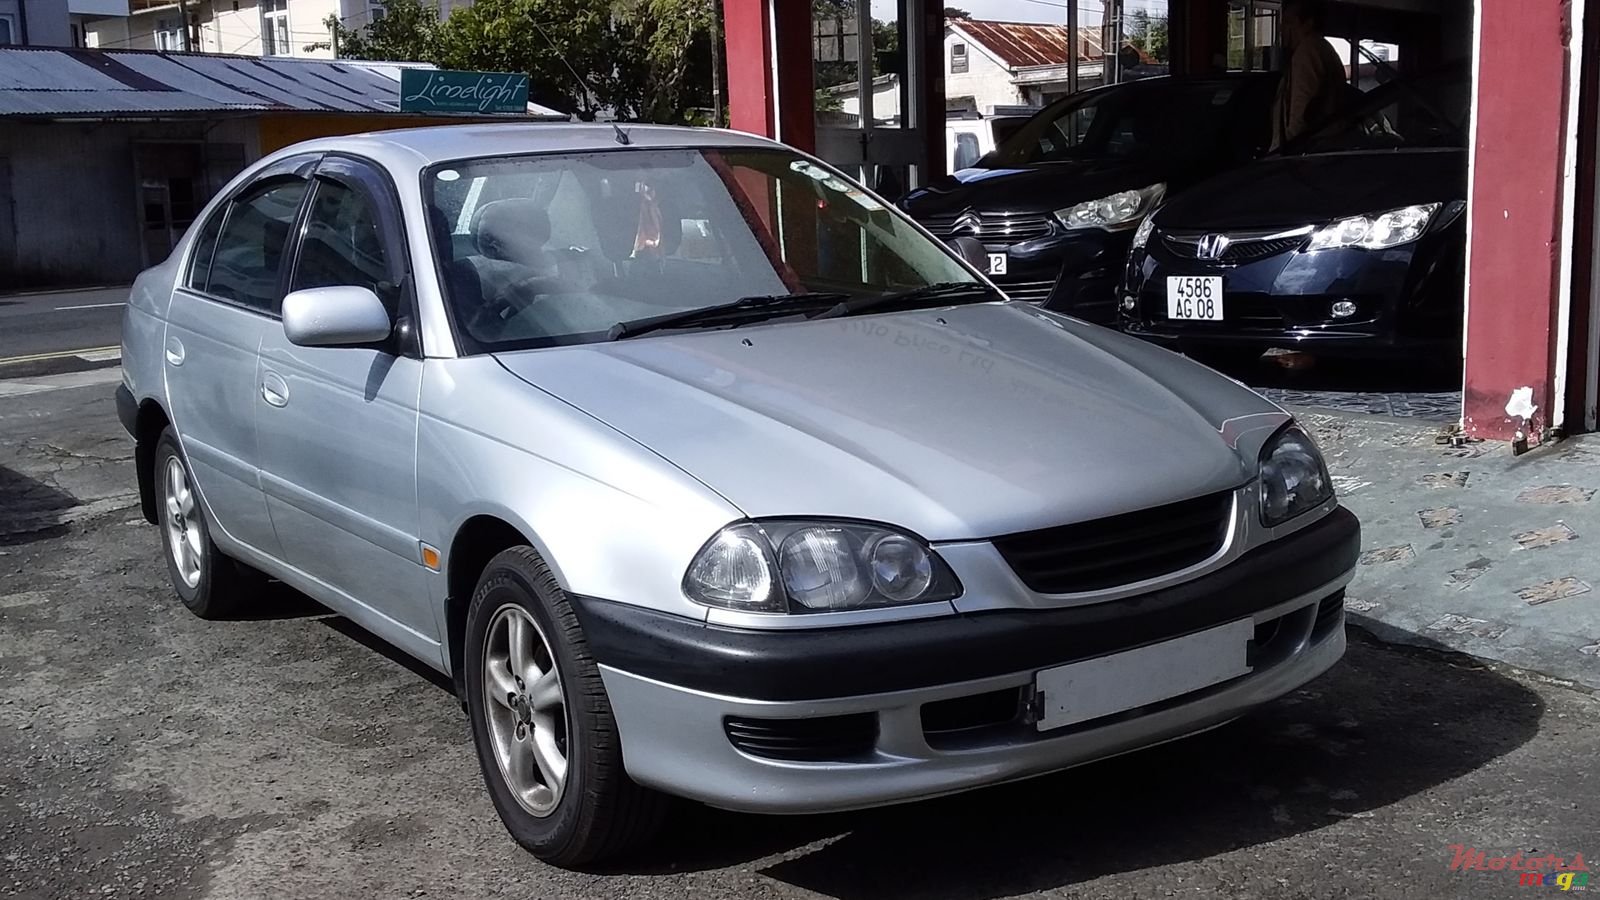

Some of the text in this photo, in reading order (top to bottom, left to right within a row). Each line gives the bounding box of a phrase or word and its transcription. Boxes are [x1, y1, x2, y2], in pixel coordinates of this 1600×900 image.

[405, 73, 526, 111] Limelight
[1177, 278, 1212, 298] 4586
[1175, 299, 1215, 318] AG 08
